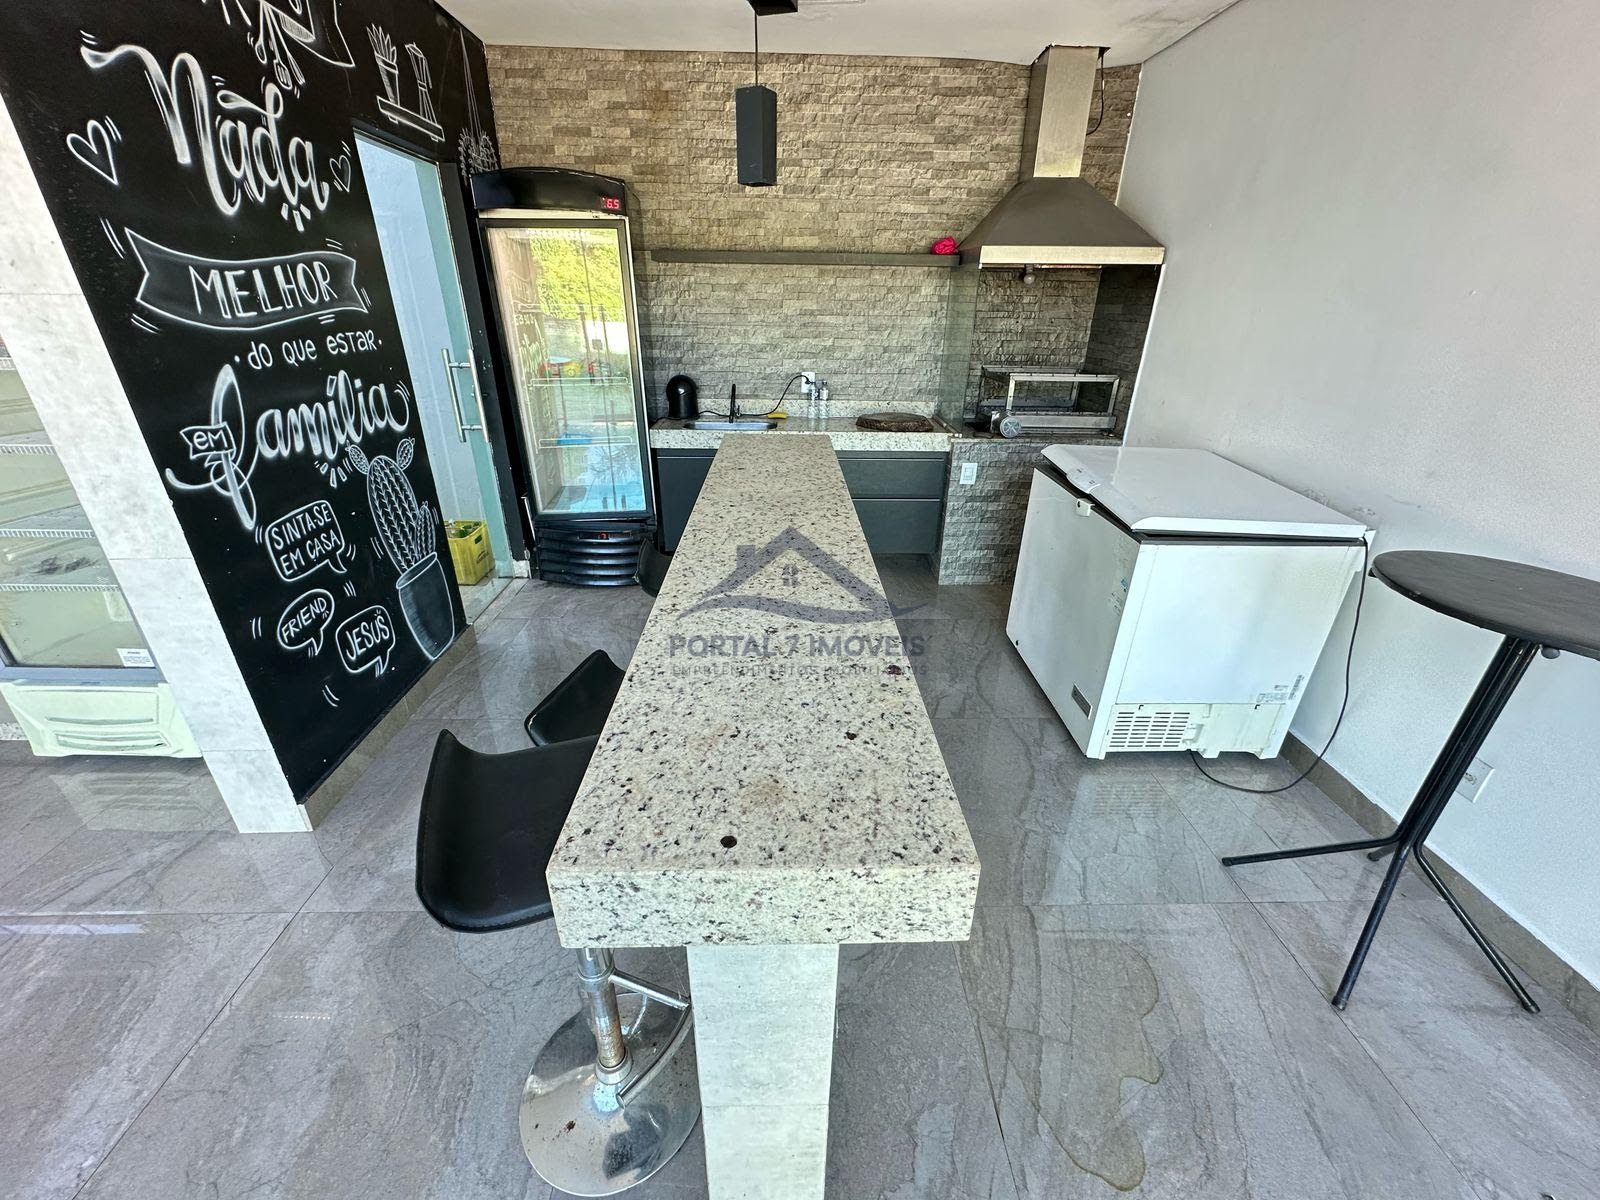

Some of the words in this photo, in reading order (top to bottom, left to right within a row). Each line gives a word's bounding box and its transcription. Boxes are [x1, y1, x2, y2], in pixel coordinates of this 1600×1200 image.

[80, 43, 330, 216] Nada
[188, 261, 338, 319] MELHOR
[271, 504, 331, 550] SINTA-SE
[280, 548, 305, 576] EM
[306, 529, 341, 560] CASA
[281, 597, 327, 643] FRIEND
[345, 615, 390, 661] JESUS
